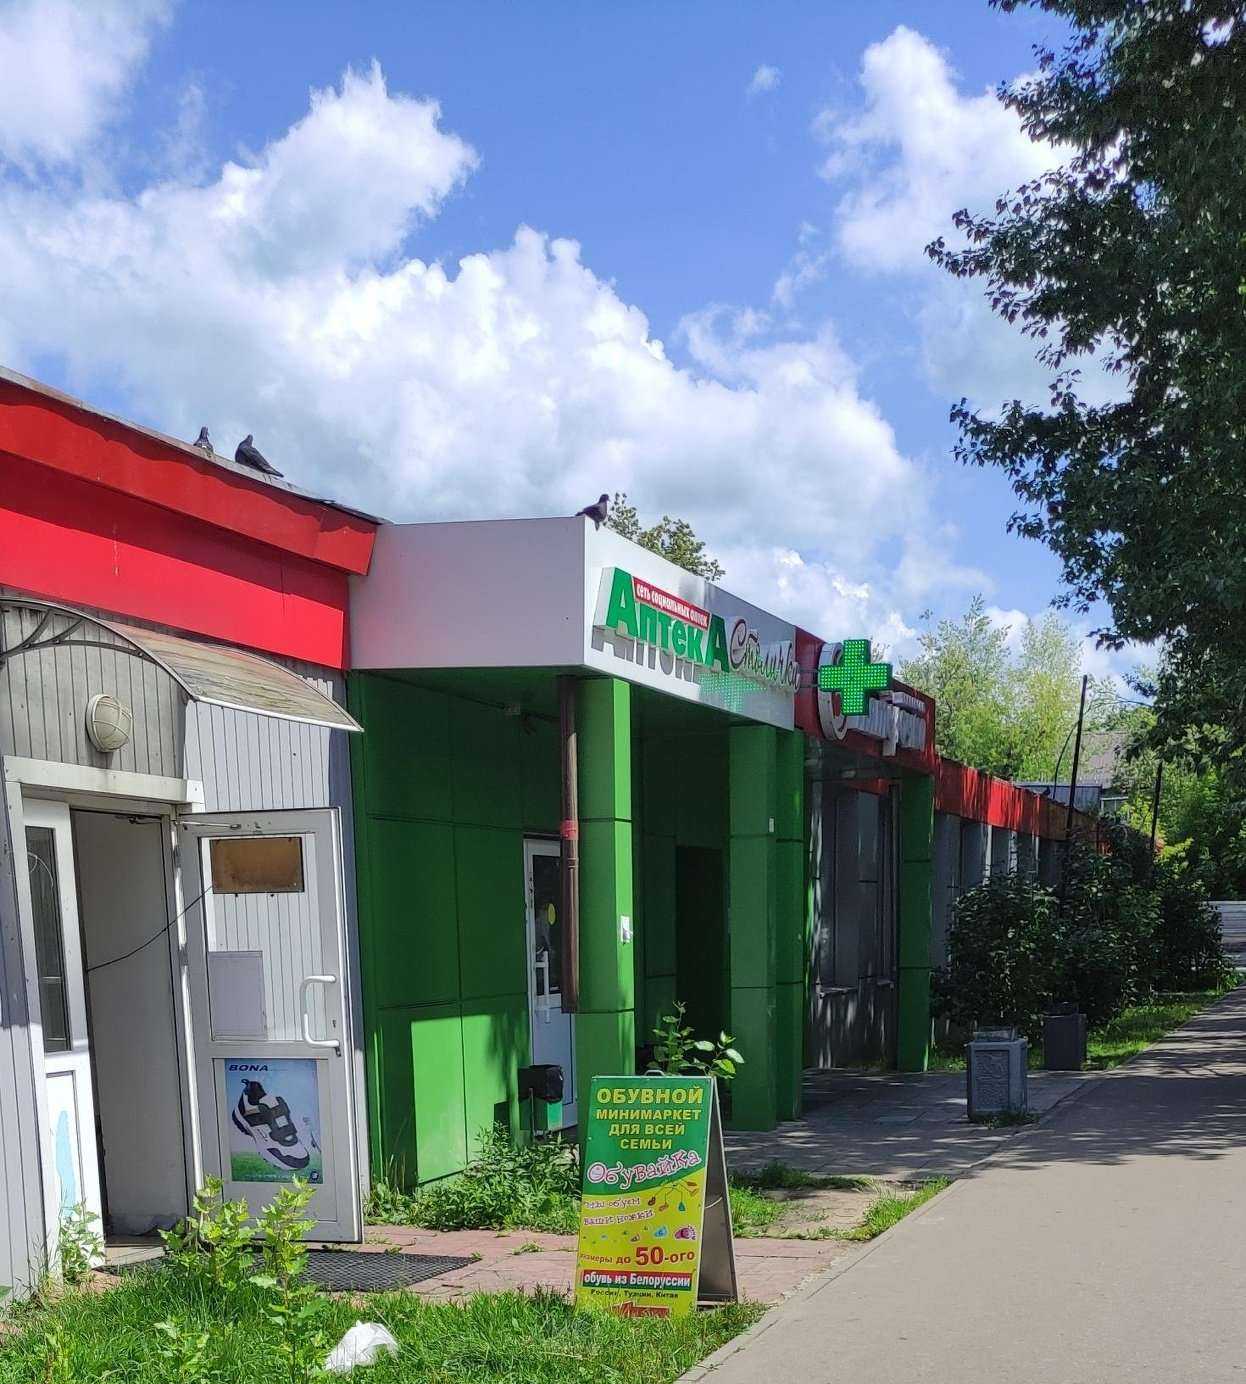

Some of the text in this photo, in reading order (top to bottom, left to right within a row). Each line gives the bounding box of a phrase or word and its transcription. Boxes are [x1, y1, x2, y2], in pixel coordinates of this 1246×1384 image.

[228, 1064, 269, 1072] BONA
[596, 1085, 704, 1104] ОБУВНОЙ
[596, 1109, 702, 1120] МИНИМАРКЕТ
[608, 1121, 685, 1136] ДЛЯ ВСЕЙ
[620, 1138, 673, 1150] СЕМЬИ
[616, 1255, 631, 1265] до
[635, 1246, 696, 1266] 50-ого
[584, 1271, 691, 1288] обувь из Белоруссии
